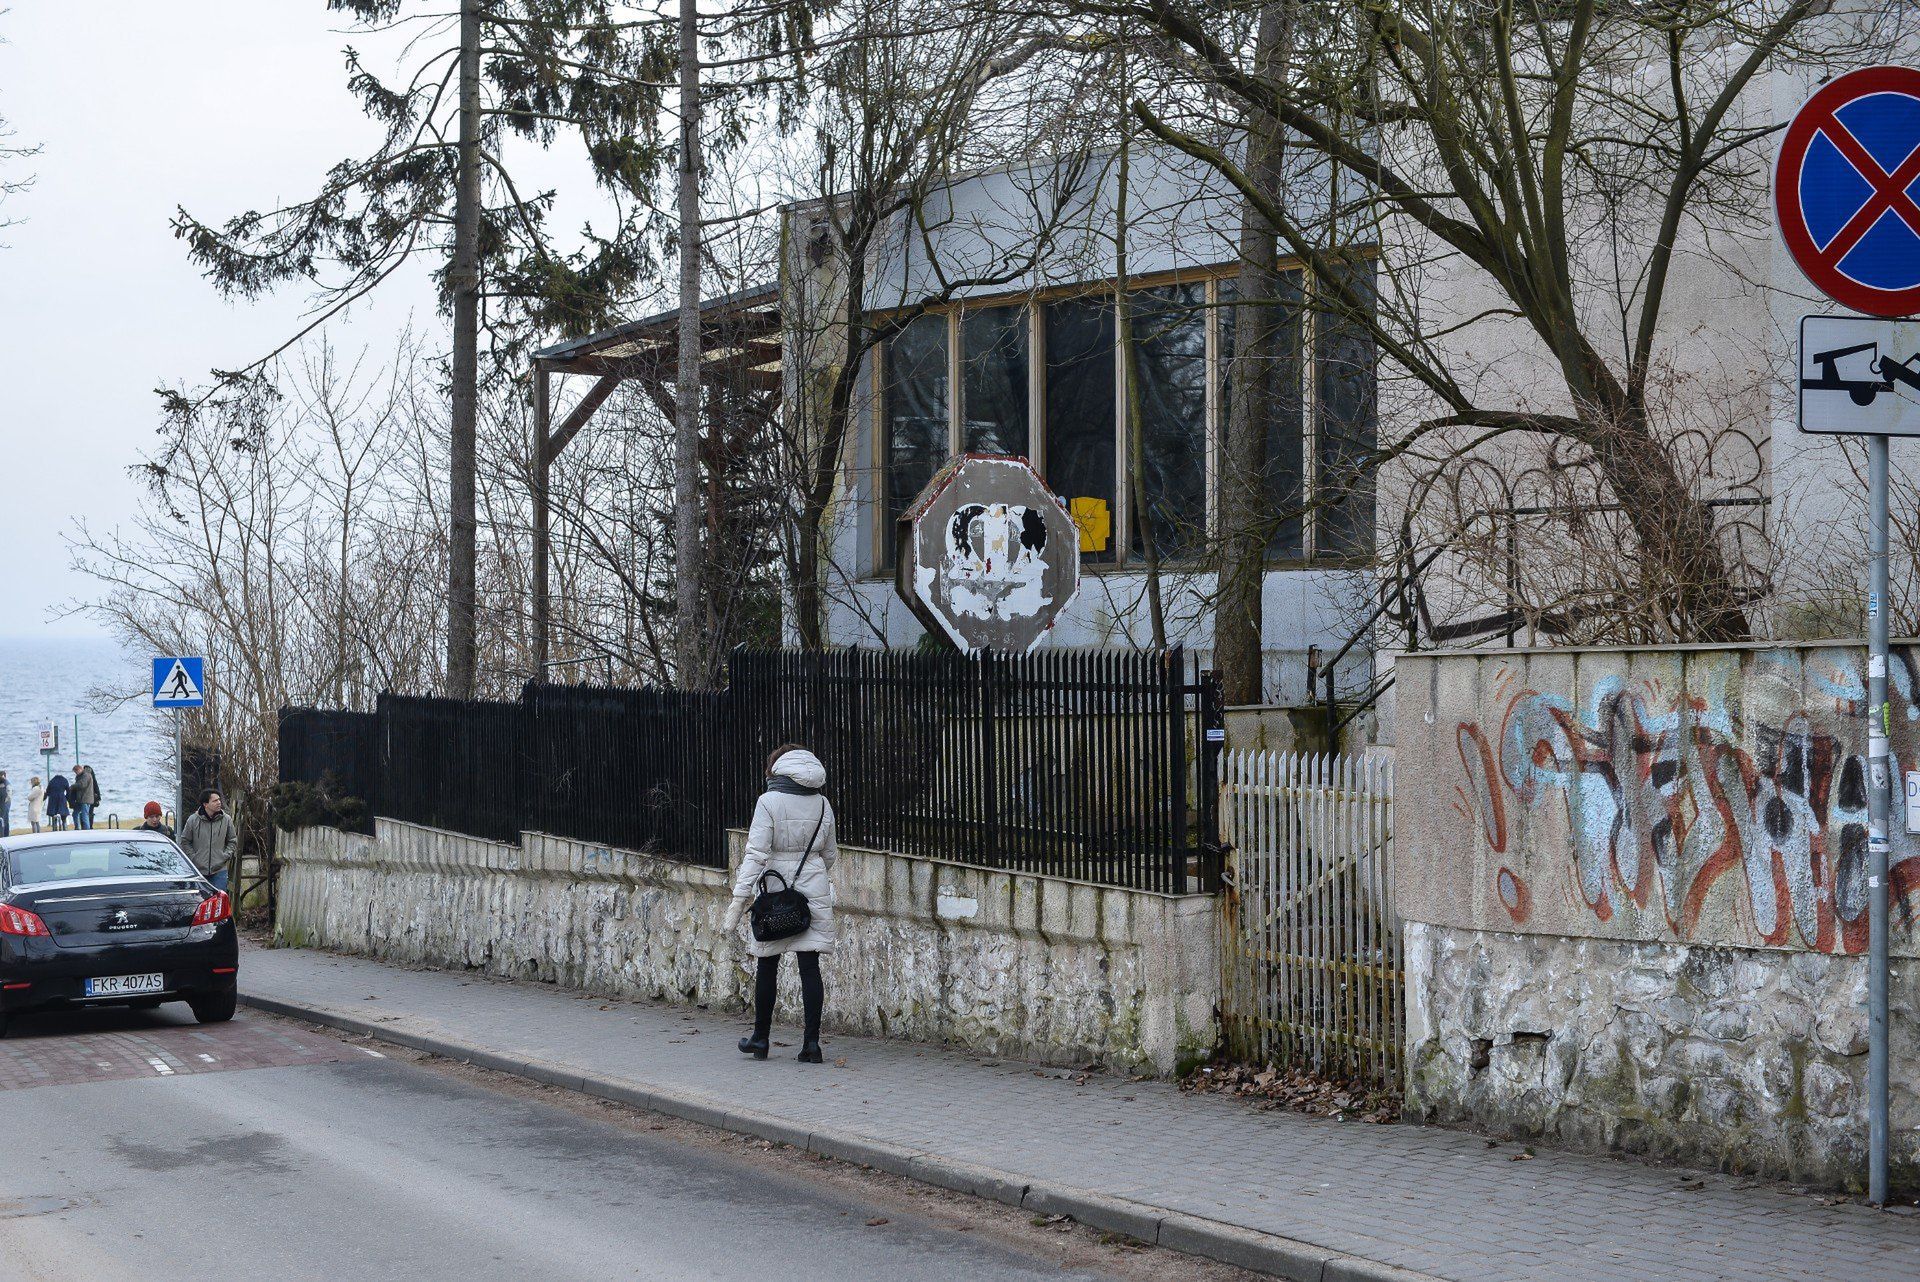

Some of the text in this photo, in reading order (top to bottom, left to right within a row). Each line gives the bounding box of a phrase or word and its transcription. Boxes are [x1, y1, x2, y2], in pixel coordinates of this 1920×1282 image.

[1908, 781, 1920, 797] D
[92, 974, 163, 992] FKR 407AS
